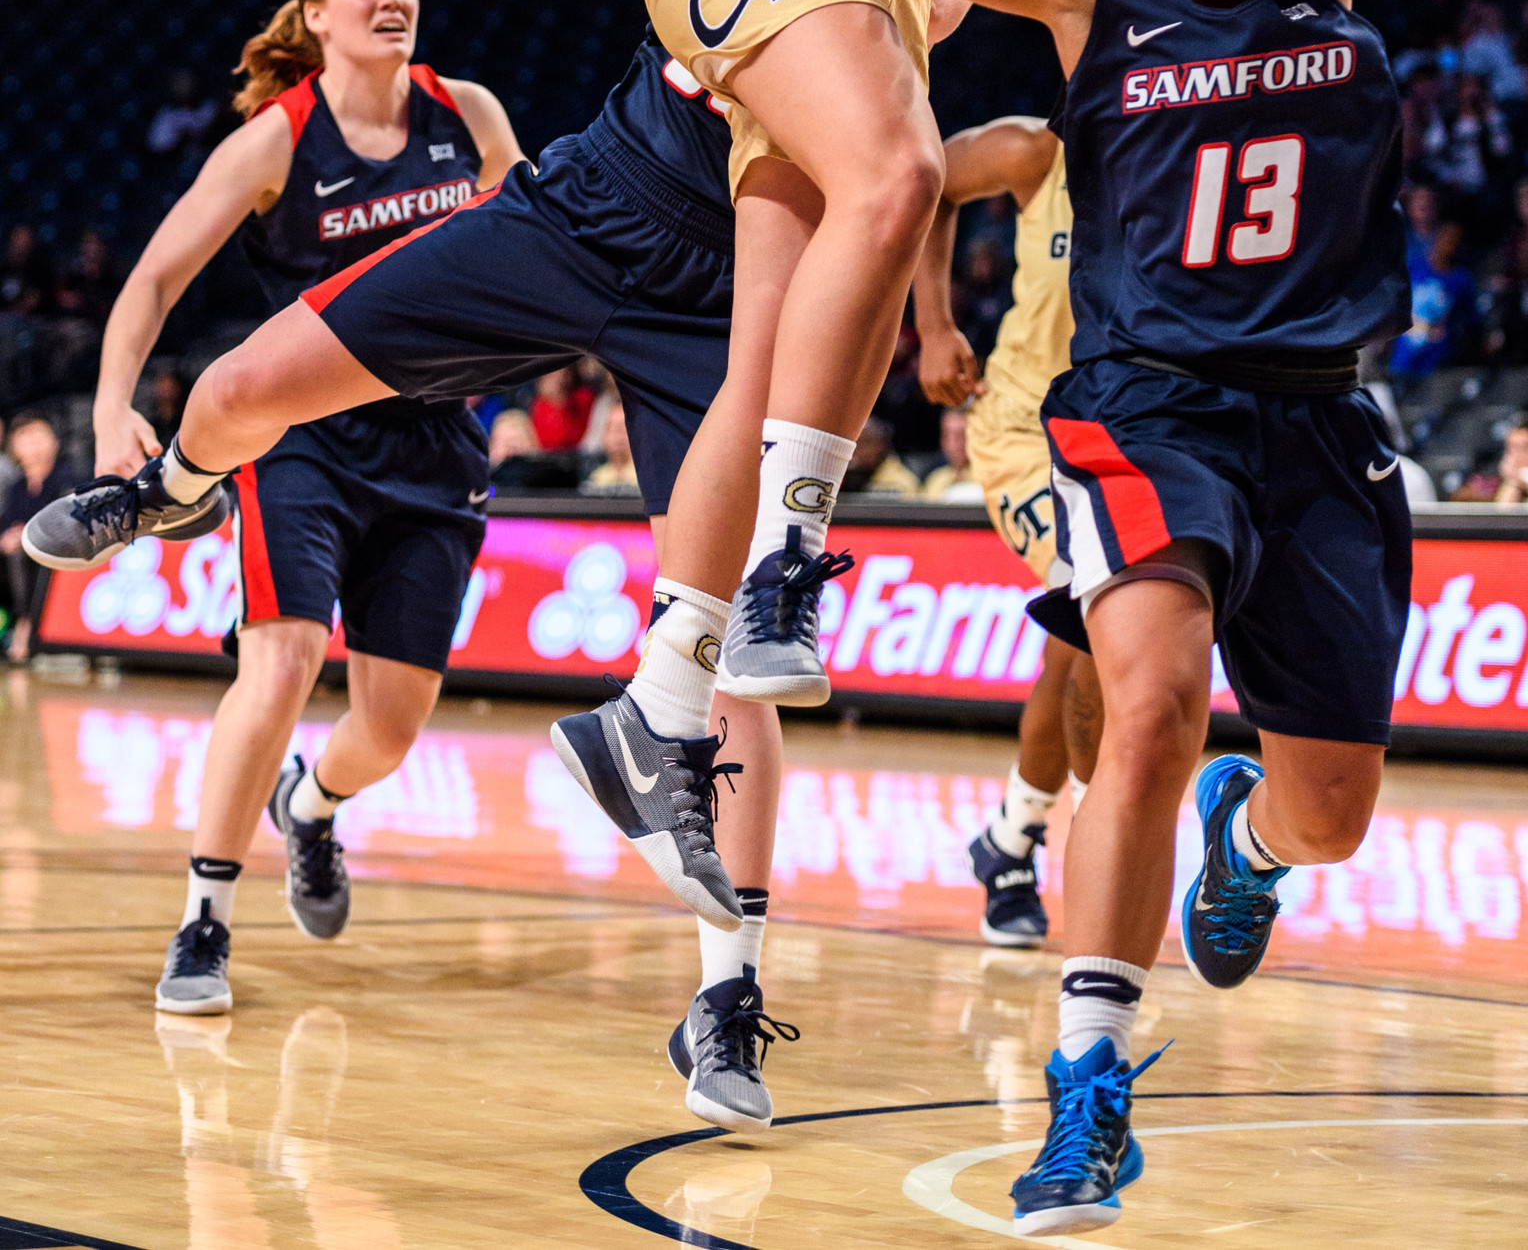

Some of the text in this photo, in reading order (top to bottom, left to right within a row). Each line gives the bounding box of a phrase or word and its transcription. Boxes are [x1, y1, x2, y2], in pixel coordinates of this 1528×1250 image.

[1123, 41, 1356, 114] SAMFORD
[319, 178, 475, 241] SAMFORD
[1182, 133, 1305, 268] 13
